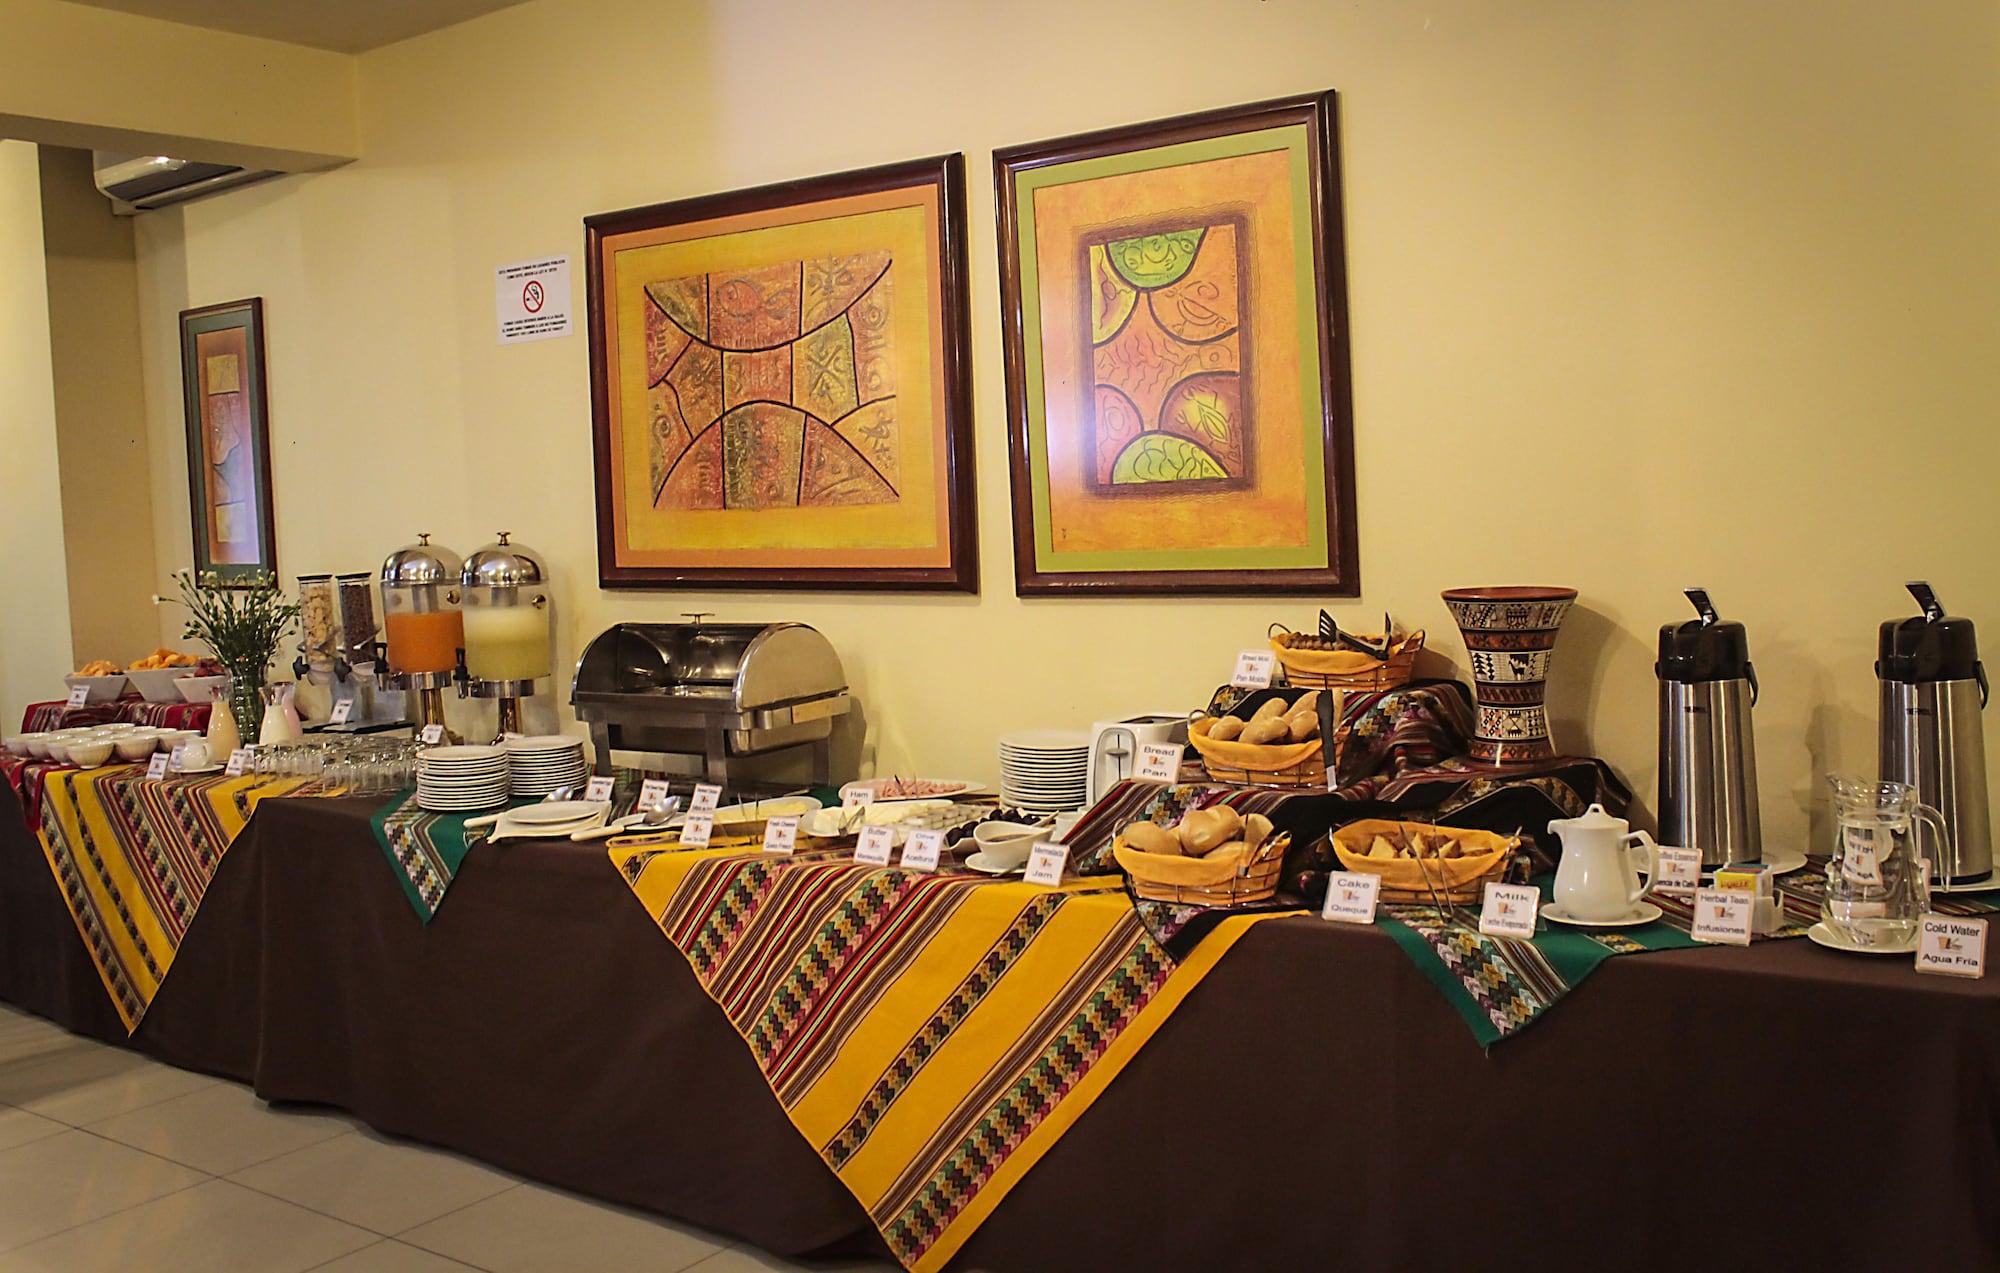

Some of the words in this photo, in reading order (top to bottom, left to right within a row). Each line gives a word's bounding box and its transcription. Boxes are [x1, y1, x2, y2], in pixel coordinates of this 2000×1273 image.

[1144, 746, 1175, 756] Bread
[1142, 768, 1167, 777] Pan
[868, 827, 887, 836] Butter
[1032, 870, 1053, 879] Jam
[1337, 878, 1370, 889] Cake
[1495, 891, 1529, 902] Milk
[1701, 894, 1727, 904] Herbal
[1729, 895, 1749, 905] Teas
[1331, 904, 1368, 914] Queque
[1696, 923, 1746, 935] Infusiones
[1924, 921, 1947, 934] Cold
[1950, 924, 1980, 937] Water
[1922, 953, 1952, 964] Agua
